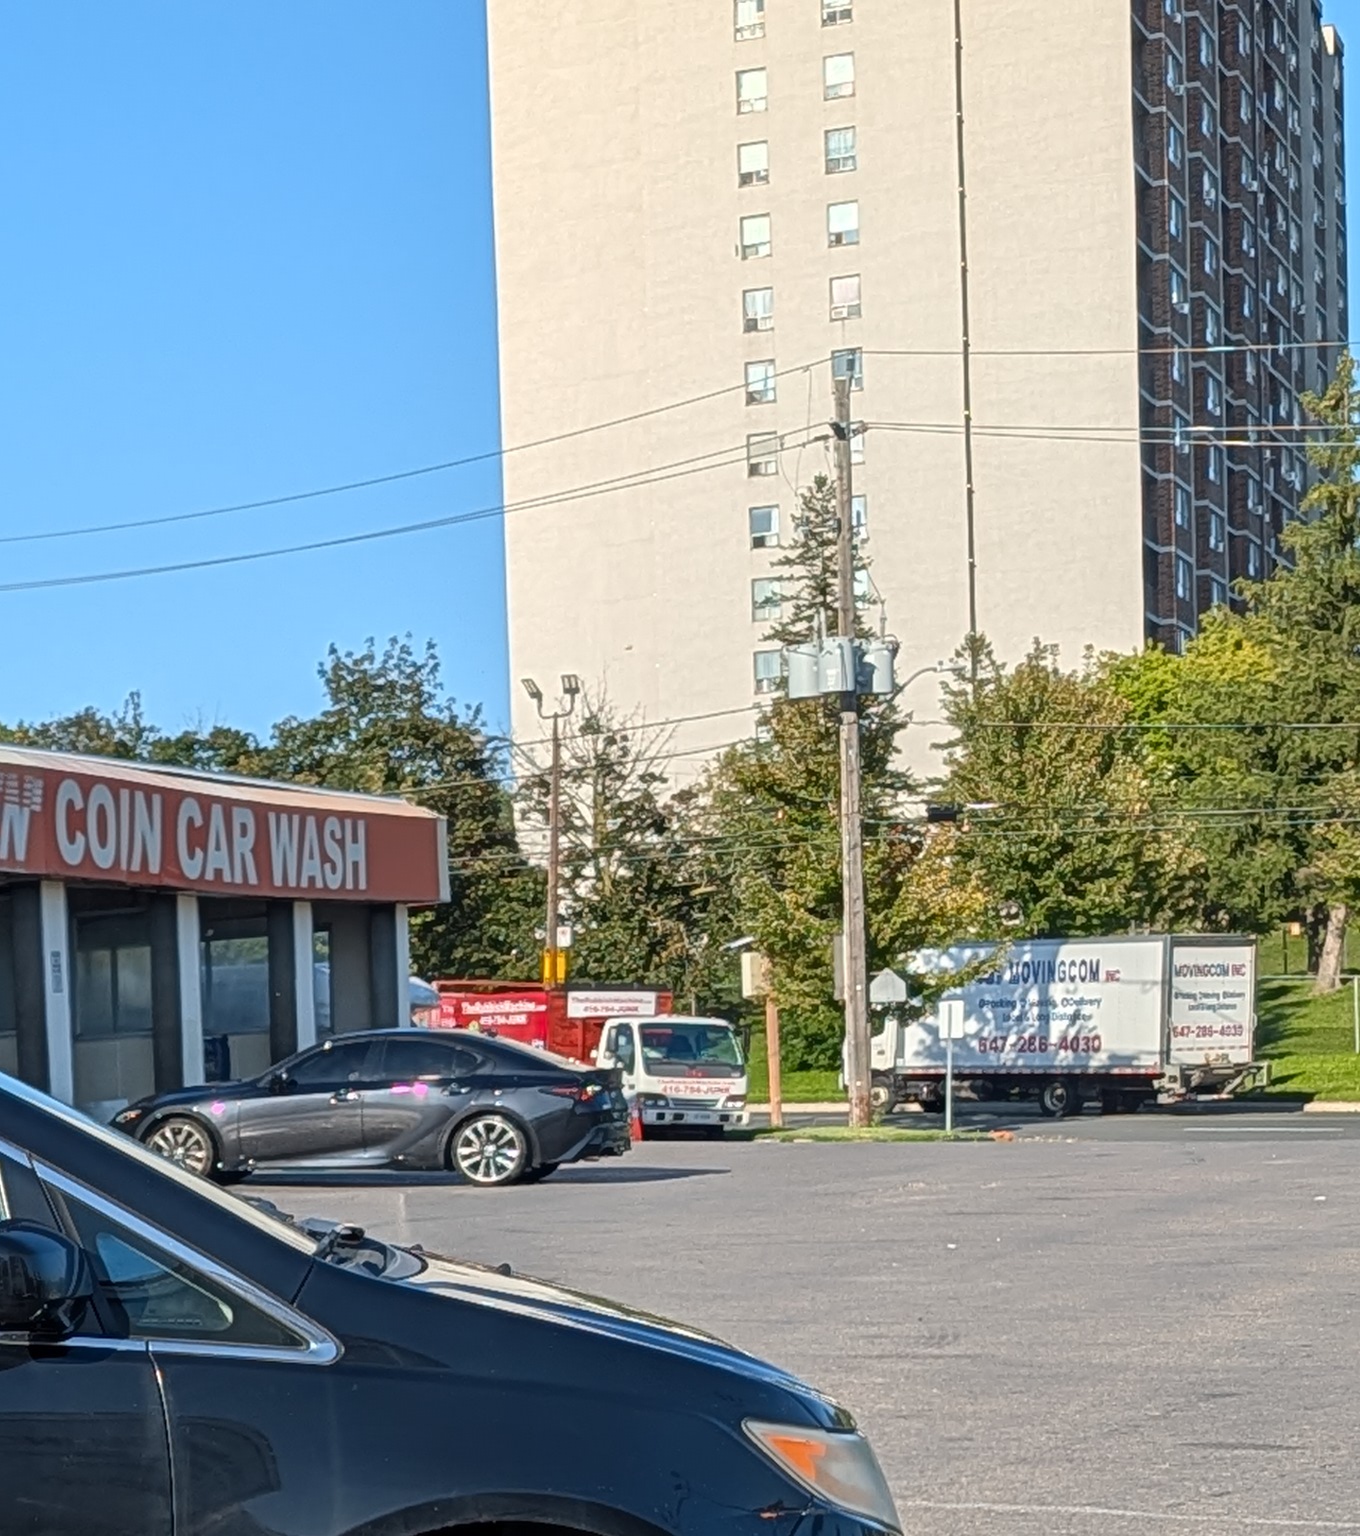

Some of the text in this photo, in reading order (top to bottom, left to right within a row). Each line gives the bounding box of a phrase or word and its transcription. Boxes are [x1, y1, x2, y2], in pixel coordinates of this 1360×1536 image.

[55, 778, 162, 875] COIN
[177, 797, 258, 886] CAR
[268, 811, 368, 891] WASH
[978, 1034, 1102, 1053] 647-286-4030
